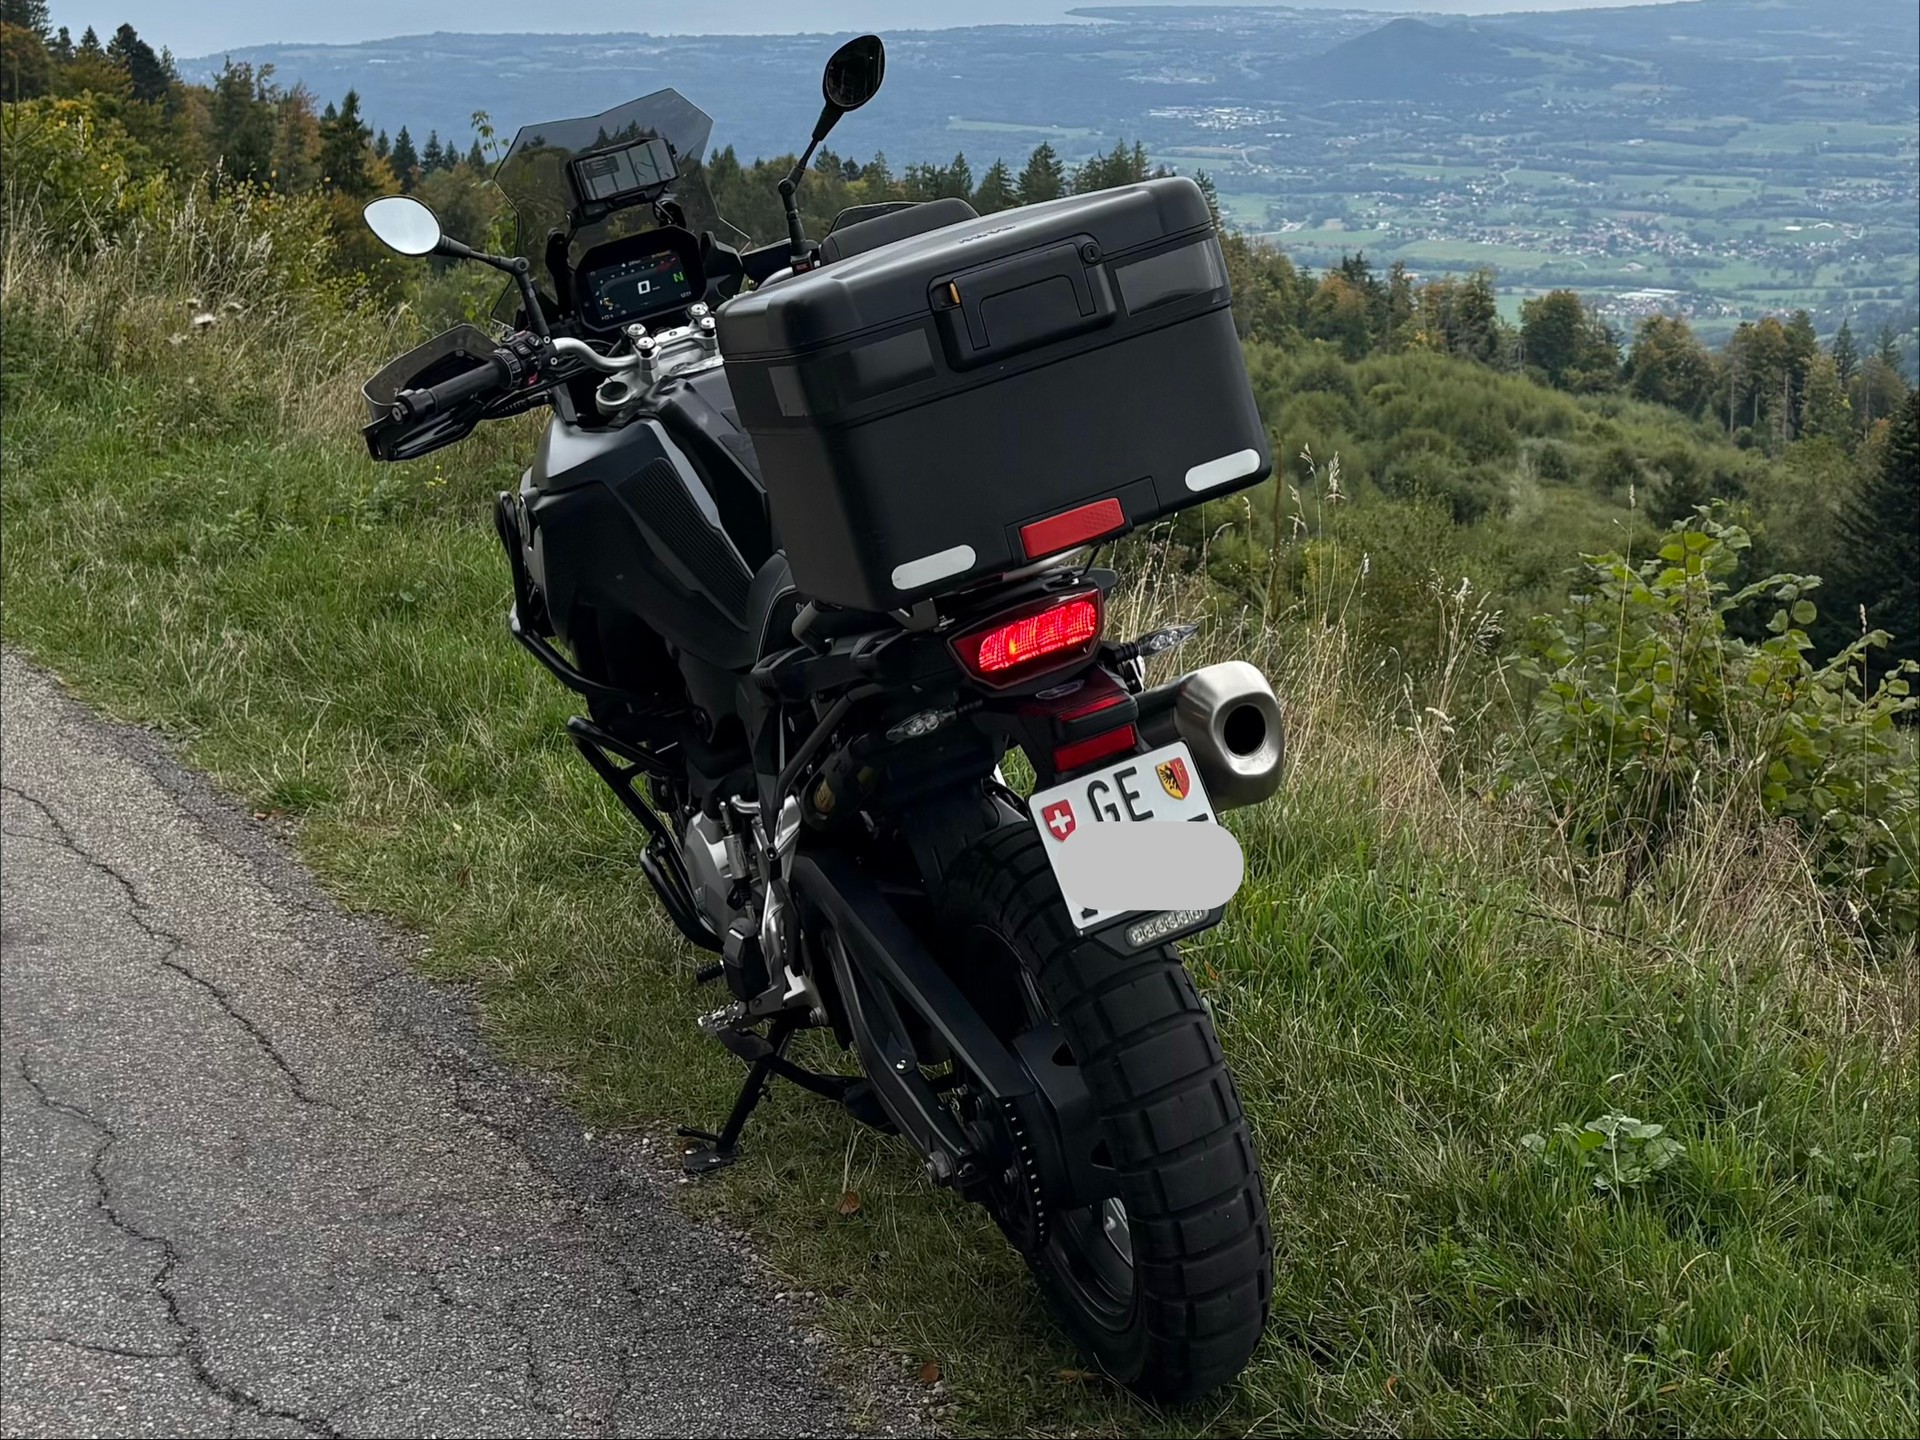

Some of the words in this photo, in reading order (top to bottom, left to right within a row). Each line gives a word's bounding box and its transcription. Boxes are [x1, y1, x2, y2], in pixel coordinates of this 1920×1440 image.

[673, 272, 684, 282] N
[637, 280, 650, 294] 0
[1086, 766, 1155, 822] GE
